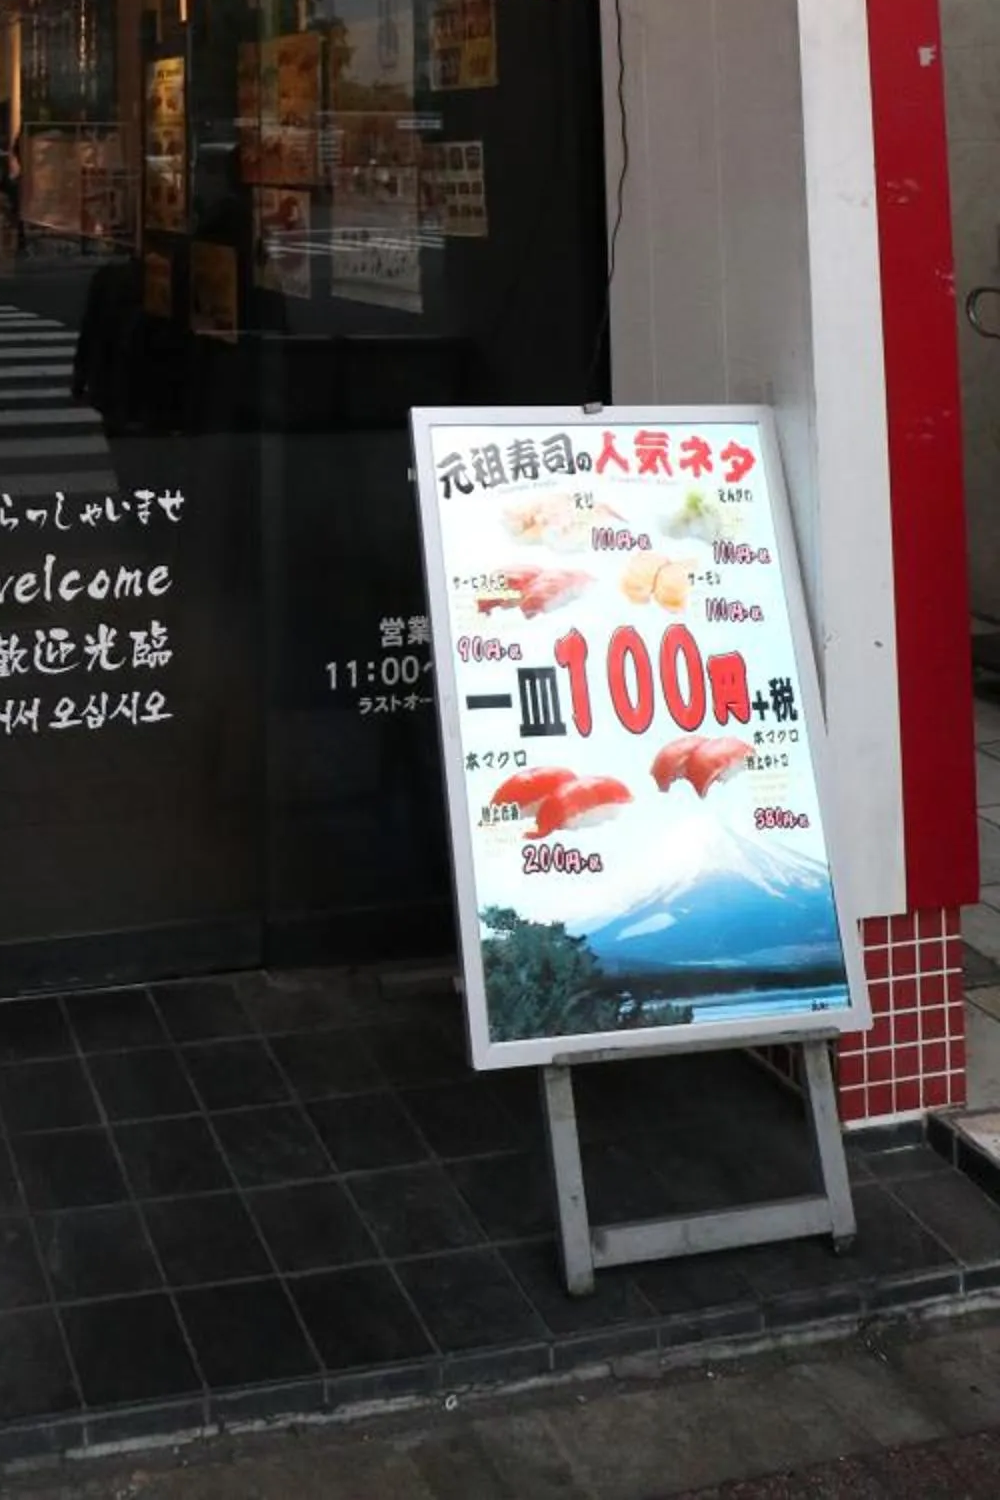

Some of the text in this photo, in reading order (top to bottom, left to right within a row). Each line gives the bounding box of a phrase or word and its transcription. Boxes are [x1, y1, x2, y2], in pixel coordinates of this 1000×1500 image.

[437, 430, 757, 499] 元祖寿司の人気ネタ
[49, 691, 174, 731] 오십시오
